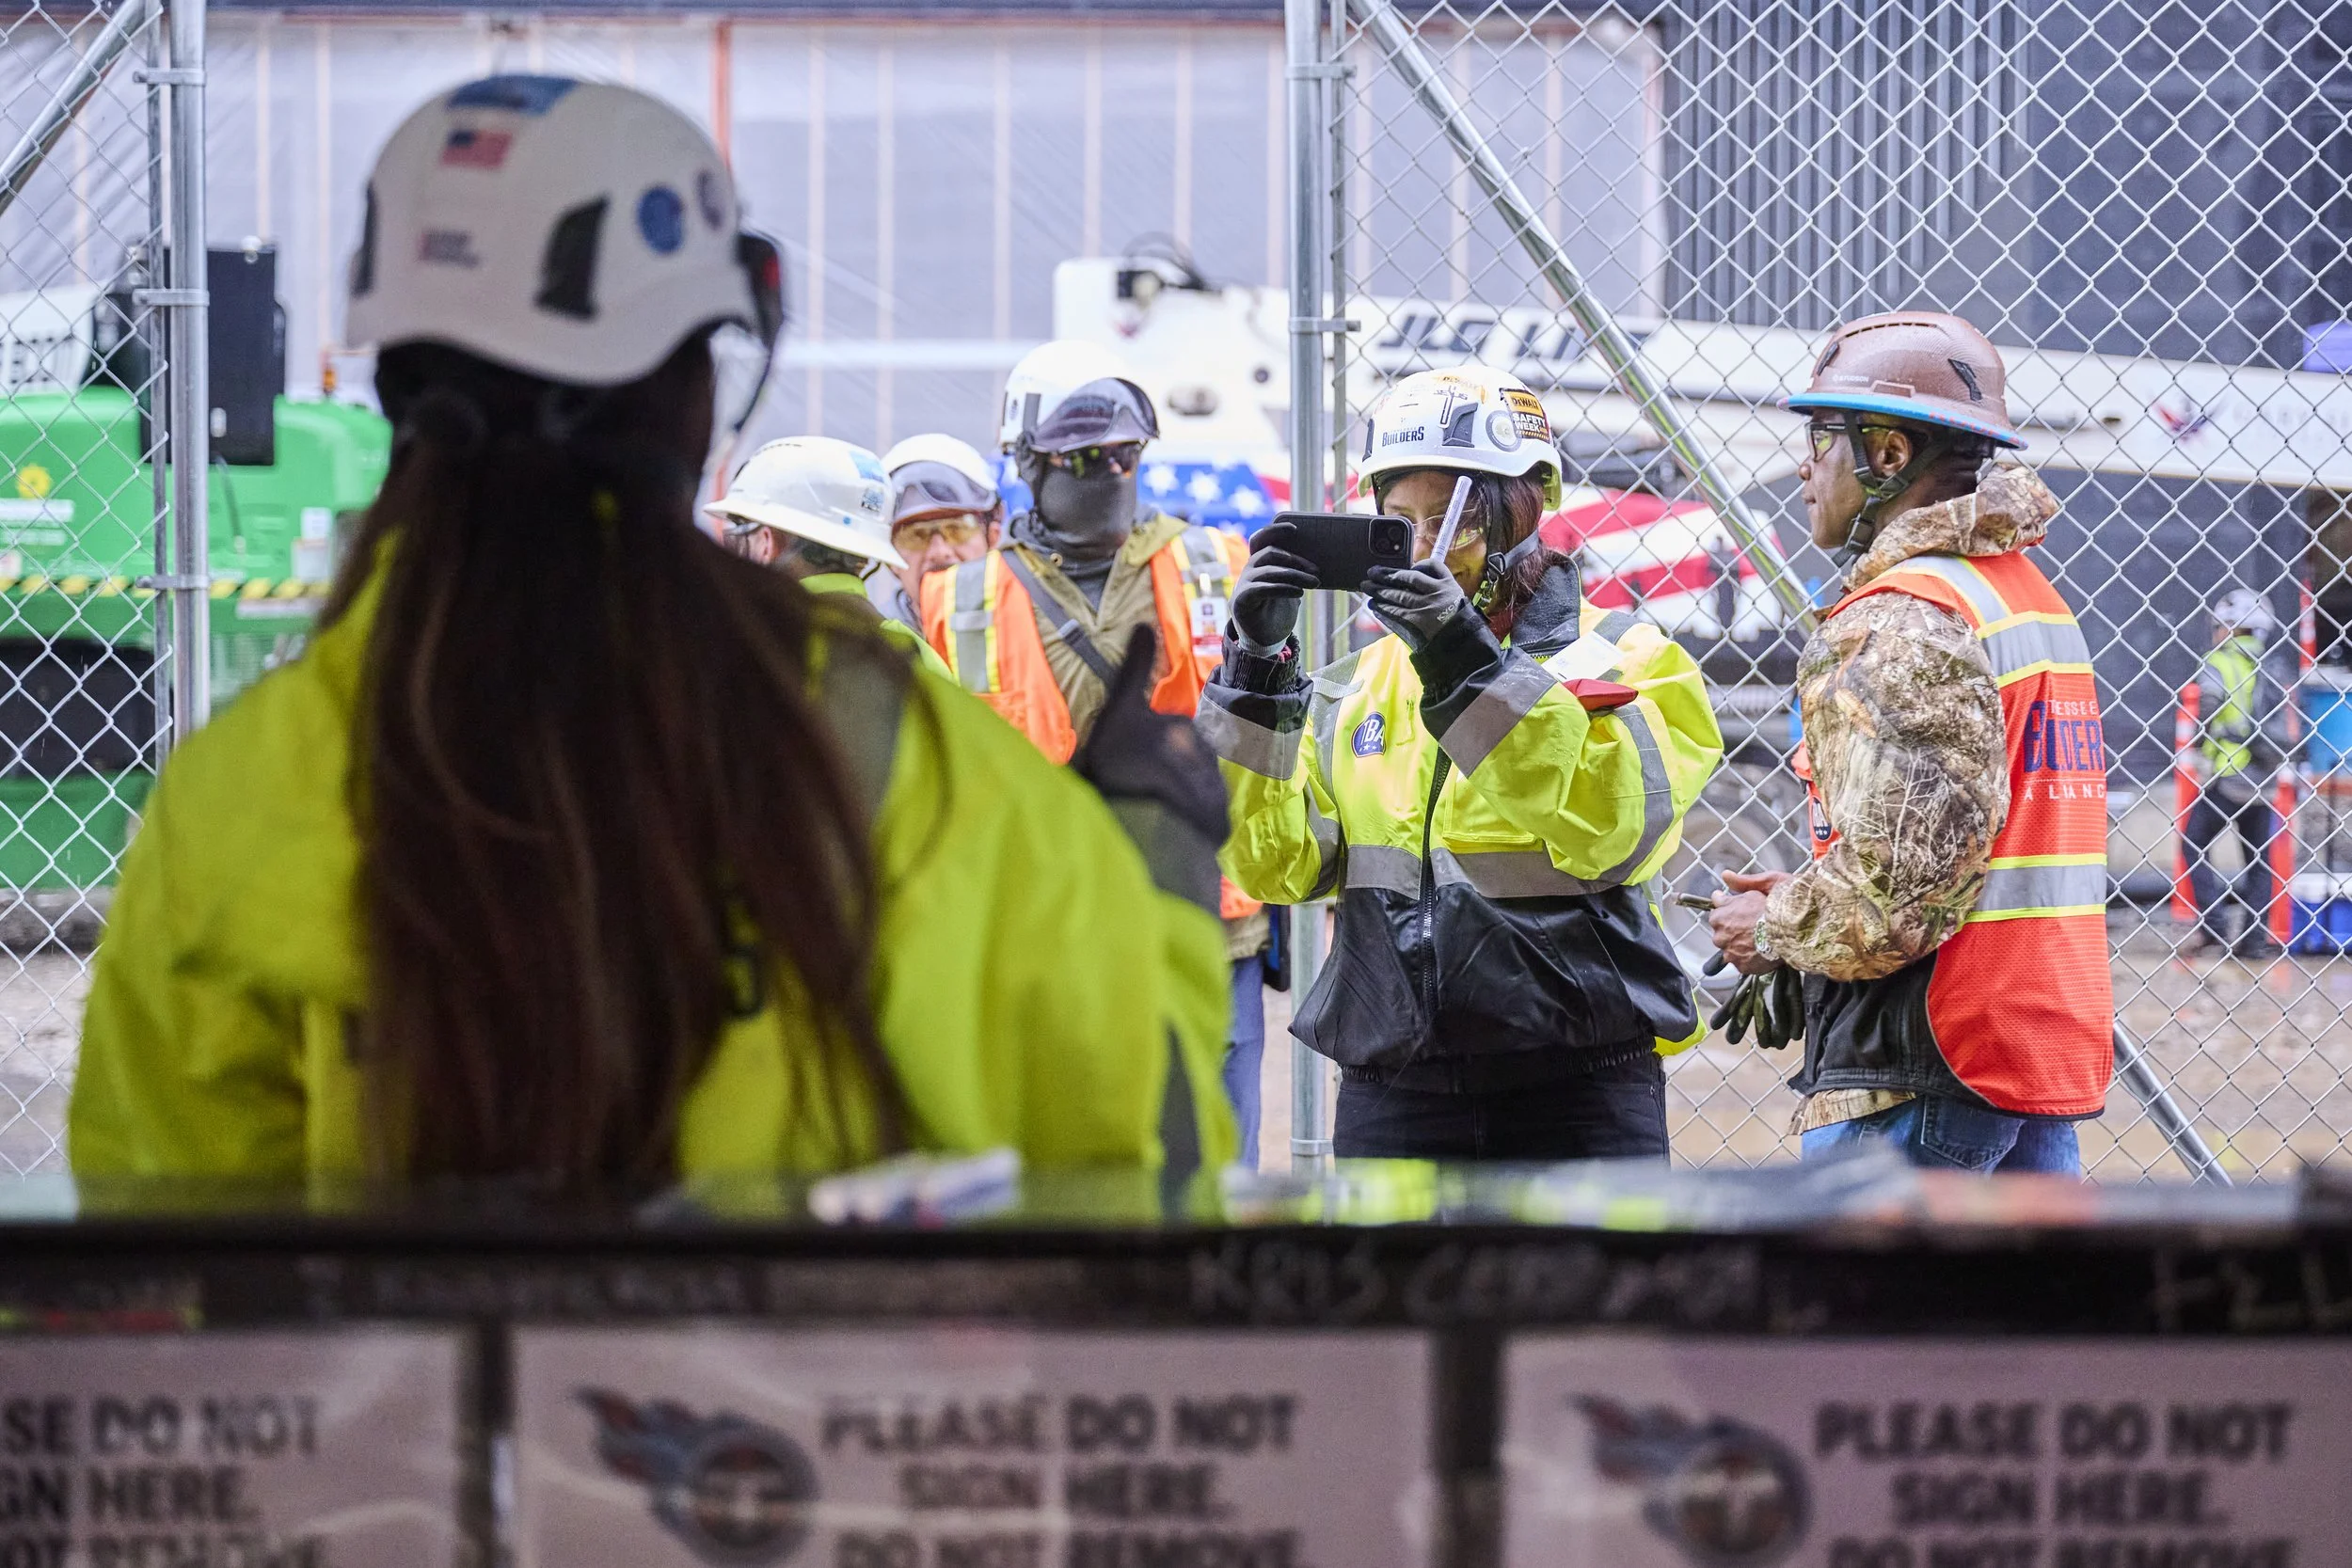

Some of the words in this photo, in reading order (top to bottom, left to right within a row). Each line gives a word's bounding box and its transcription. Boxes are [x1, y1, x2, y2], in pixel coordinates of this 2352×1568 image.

[1382, 426, 1424, 447] BUILDERS
[1513, 412, 1546, 427] SAFETY
[1515, 420, 1541, 433] WEEK
[94, 1394, 183, 1455] DO
[200, 1394, 320, 1458] NOT
[821, 1396, 1044, 1455] PLEASE
[1065, 1394, 1156, 1454] DO
[1174, 1393, 1295, 1456] NOT
[1815, 1399, 2042, 1461] PLEASE
[2060, 1400, 2153, 1462] DO
[2168, 1398, 2293, 1465] NOT
[1891, 1469, 2035, 1528] SIGN
